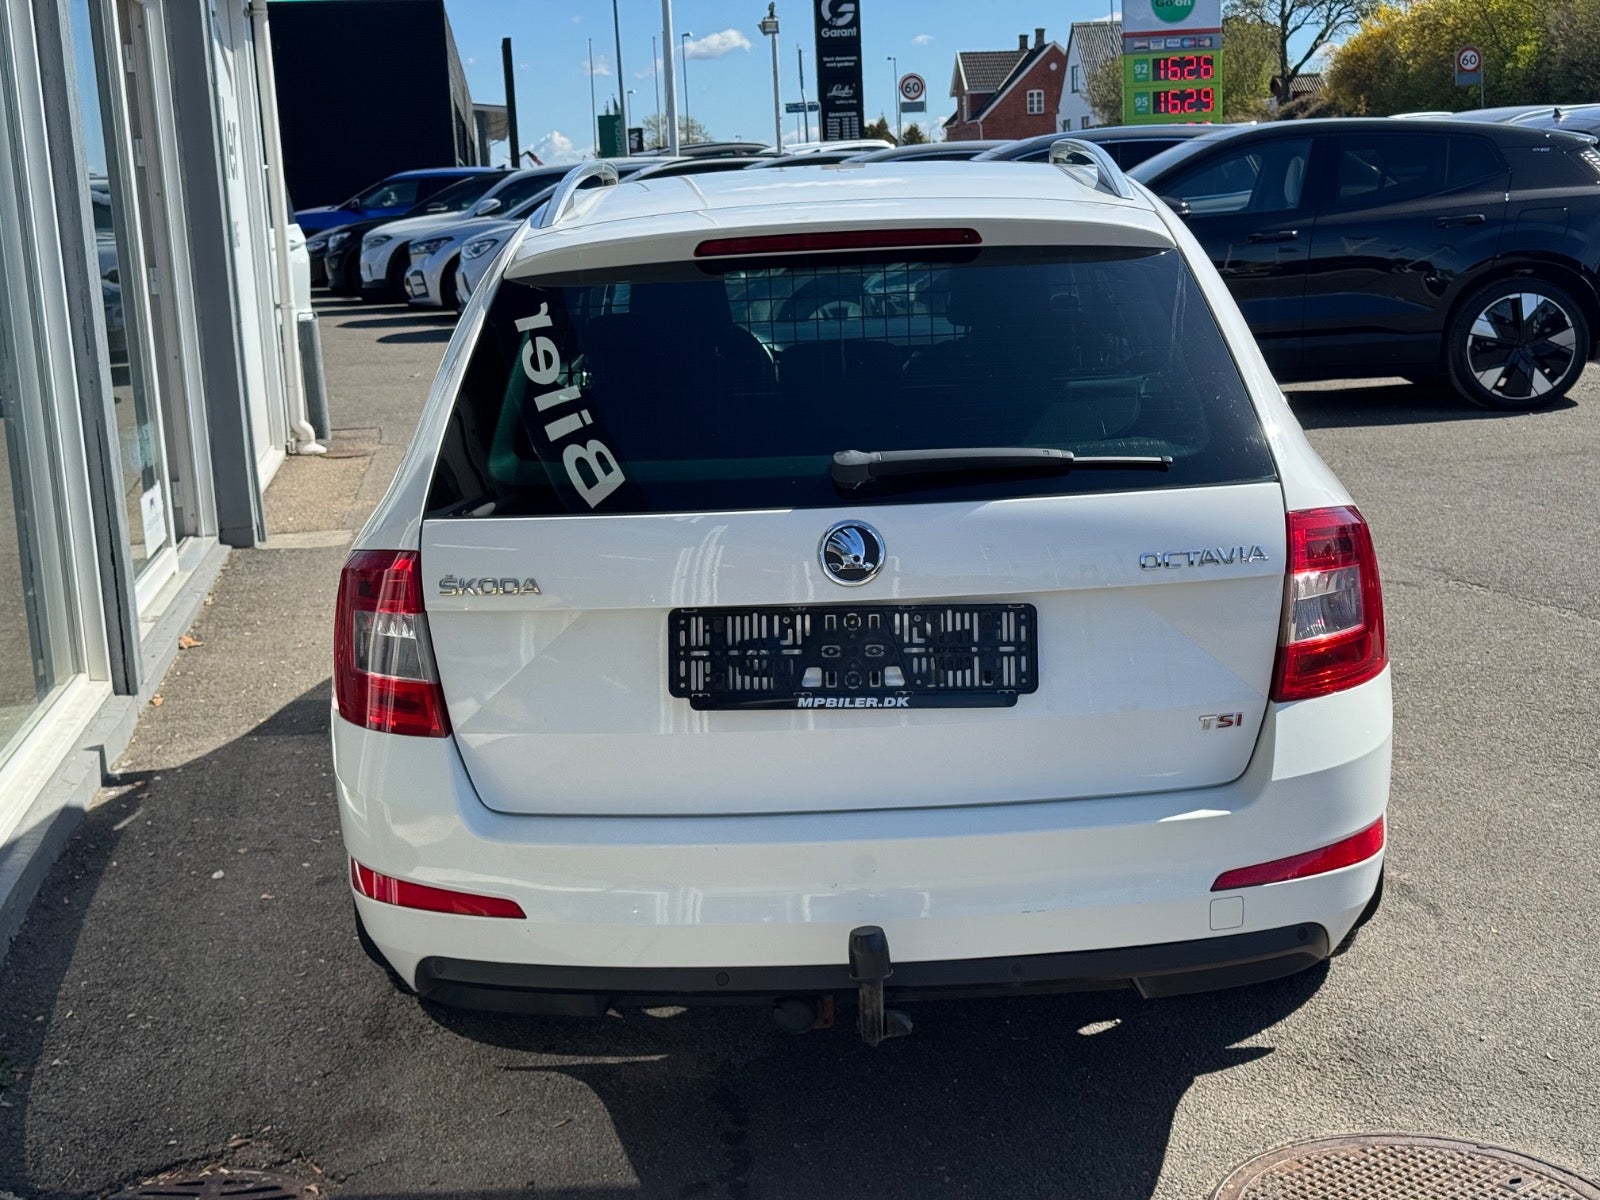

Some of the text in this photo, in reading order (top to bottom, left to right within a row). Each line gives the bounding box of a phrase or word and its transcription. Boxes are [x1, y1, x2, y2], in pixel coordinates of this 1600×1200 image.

[821, 27, 857, 38] Garant
[1461, 55, 1477, 66] 60
[1134, 64, 1148, 74] 92
[904, 82, 920, 94] 60
[1135, 96, 1148, 107] 95
[1139, 544, 1269, 570] OCTAVIA
[438, 574, 542, 596] ŠKODA
[797, 696, 910, 709] MPBILER.DK
[1198, 712, 1244, 731] TSI
